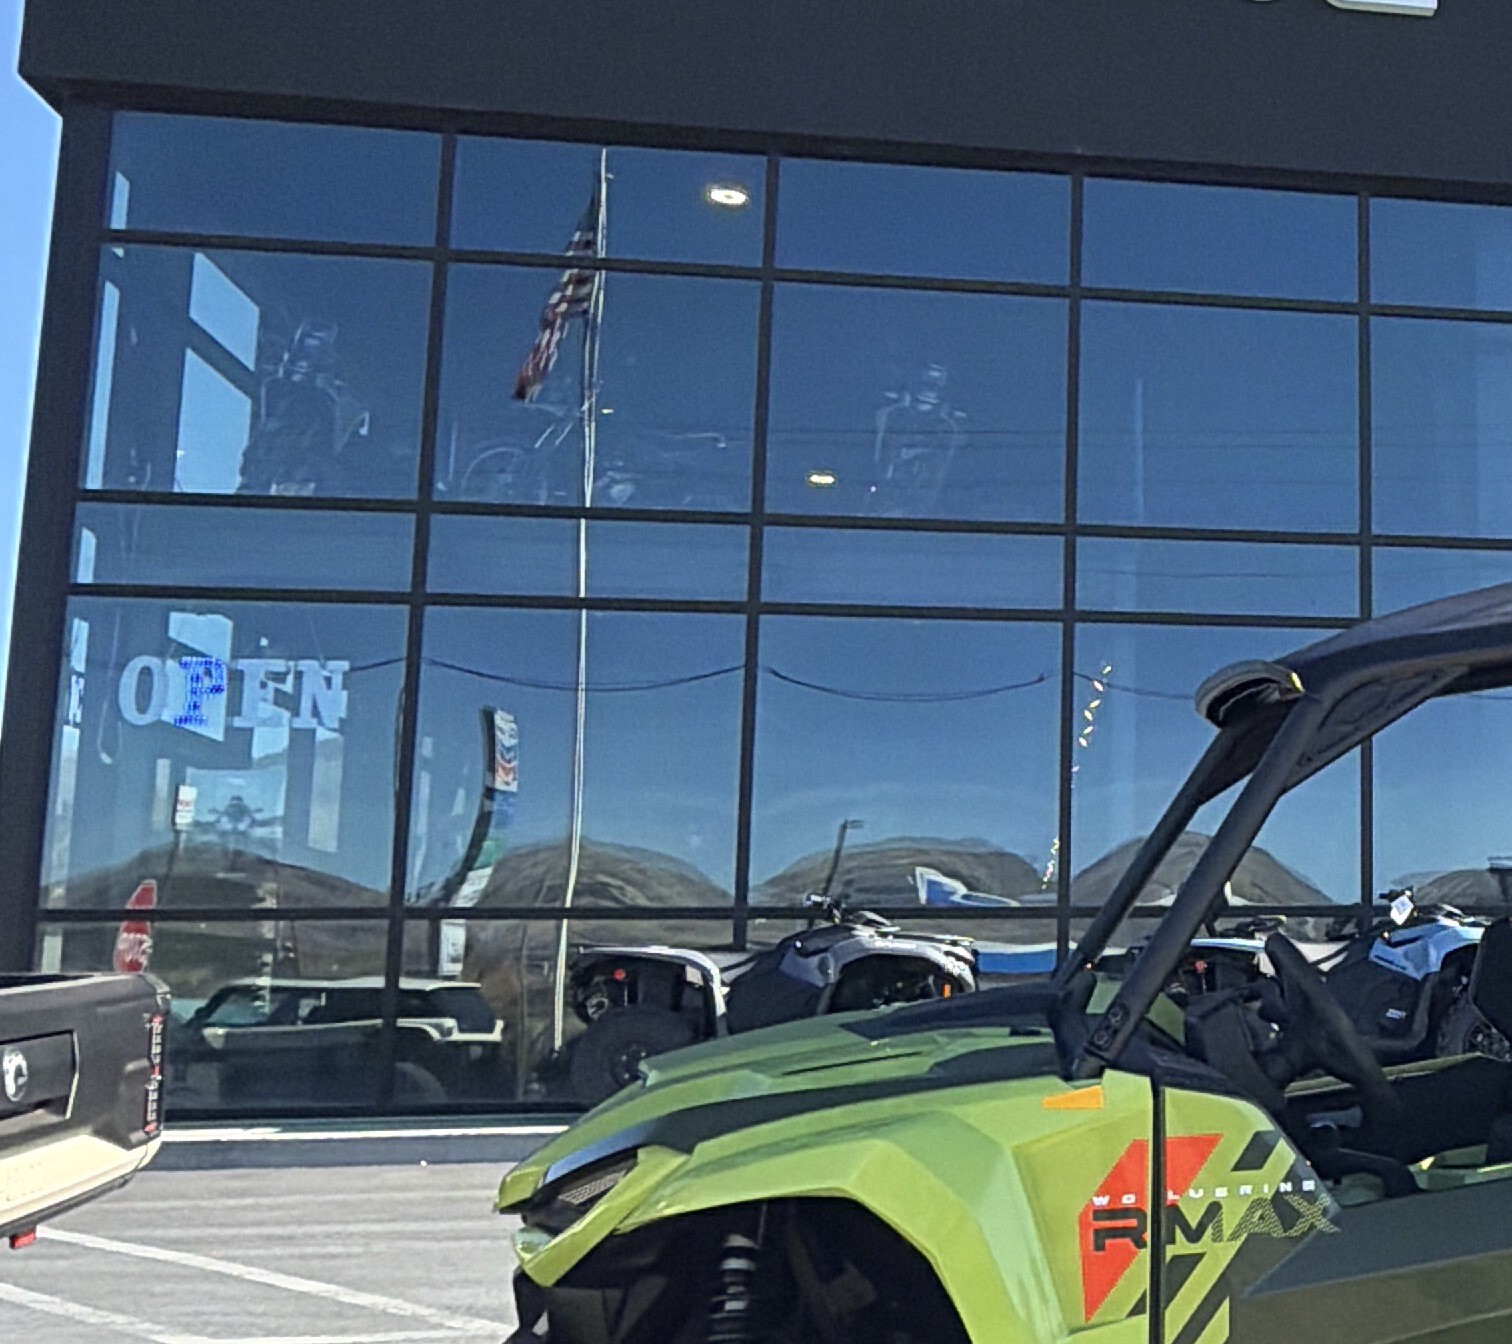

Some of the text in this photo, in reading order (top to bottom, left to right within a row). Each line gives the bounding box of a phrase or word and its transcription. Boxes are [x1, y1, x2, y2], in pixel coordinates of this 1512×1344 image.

[119, 655, 350, 730] OPEN
[1092, 1180, 1317, 1206] WOLVERINE
[1092, 1193, 1341, 1253] RMAX
